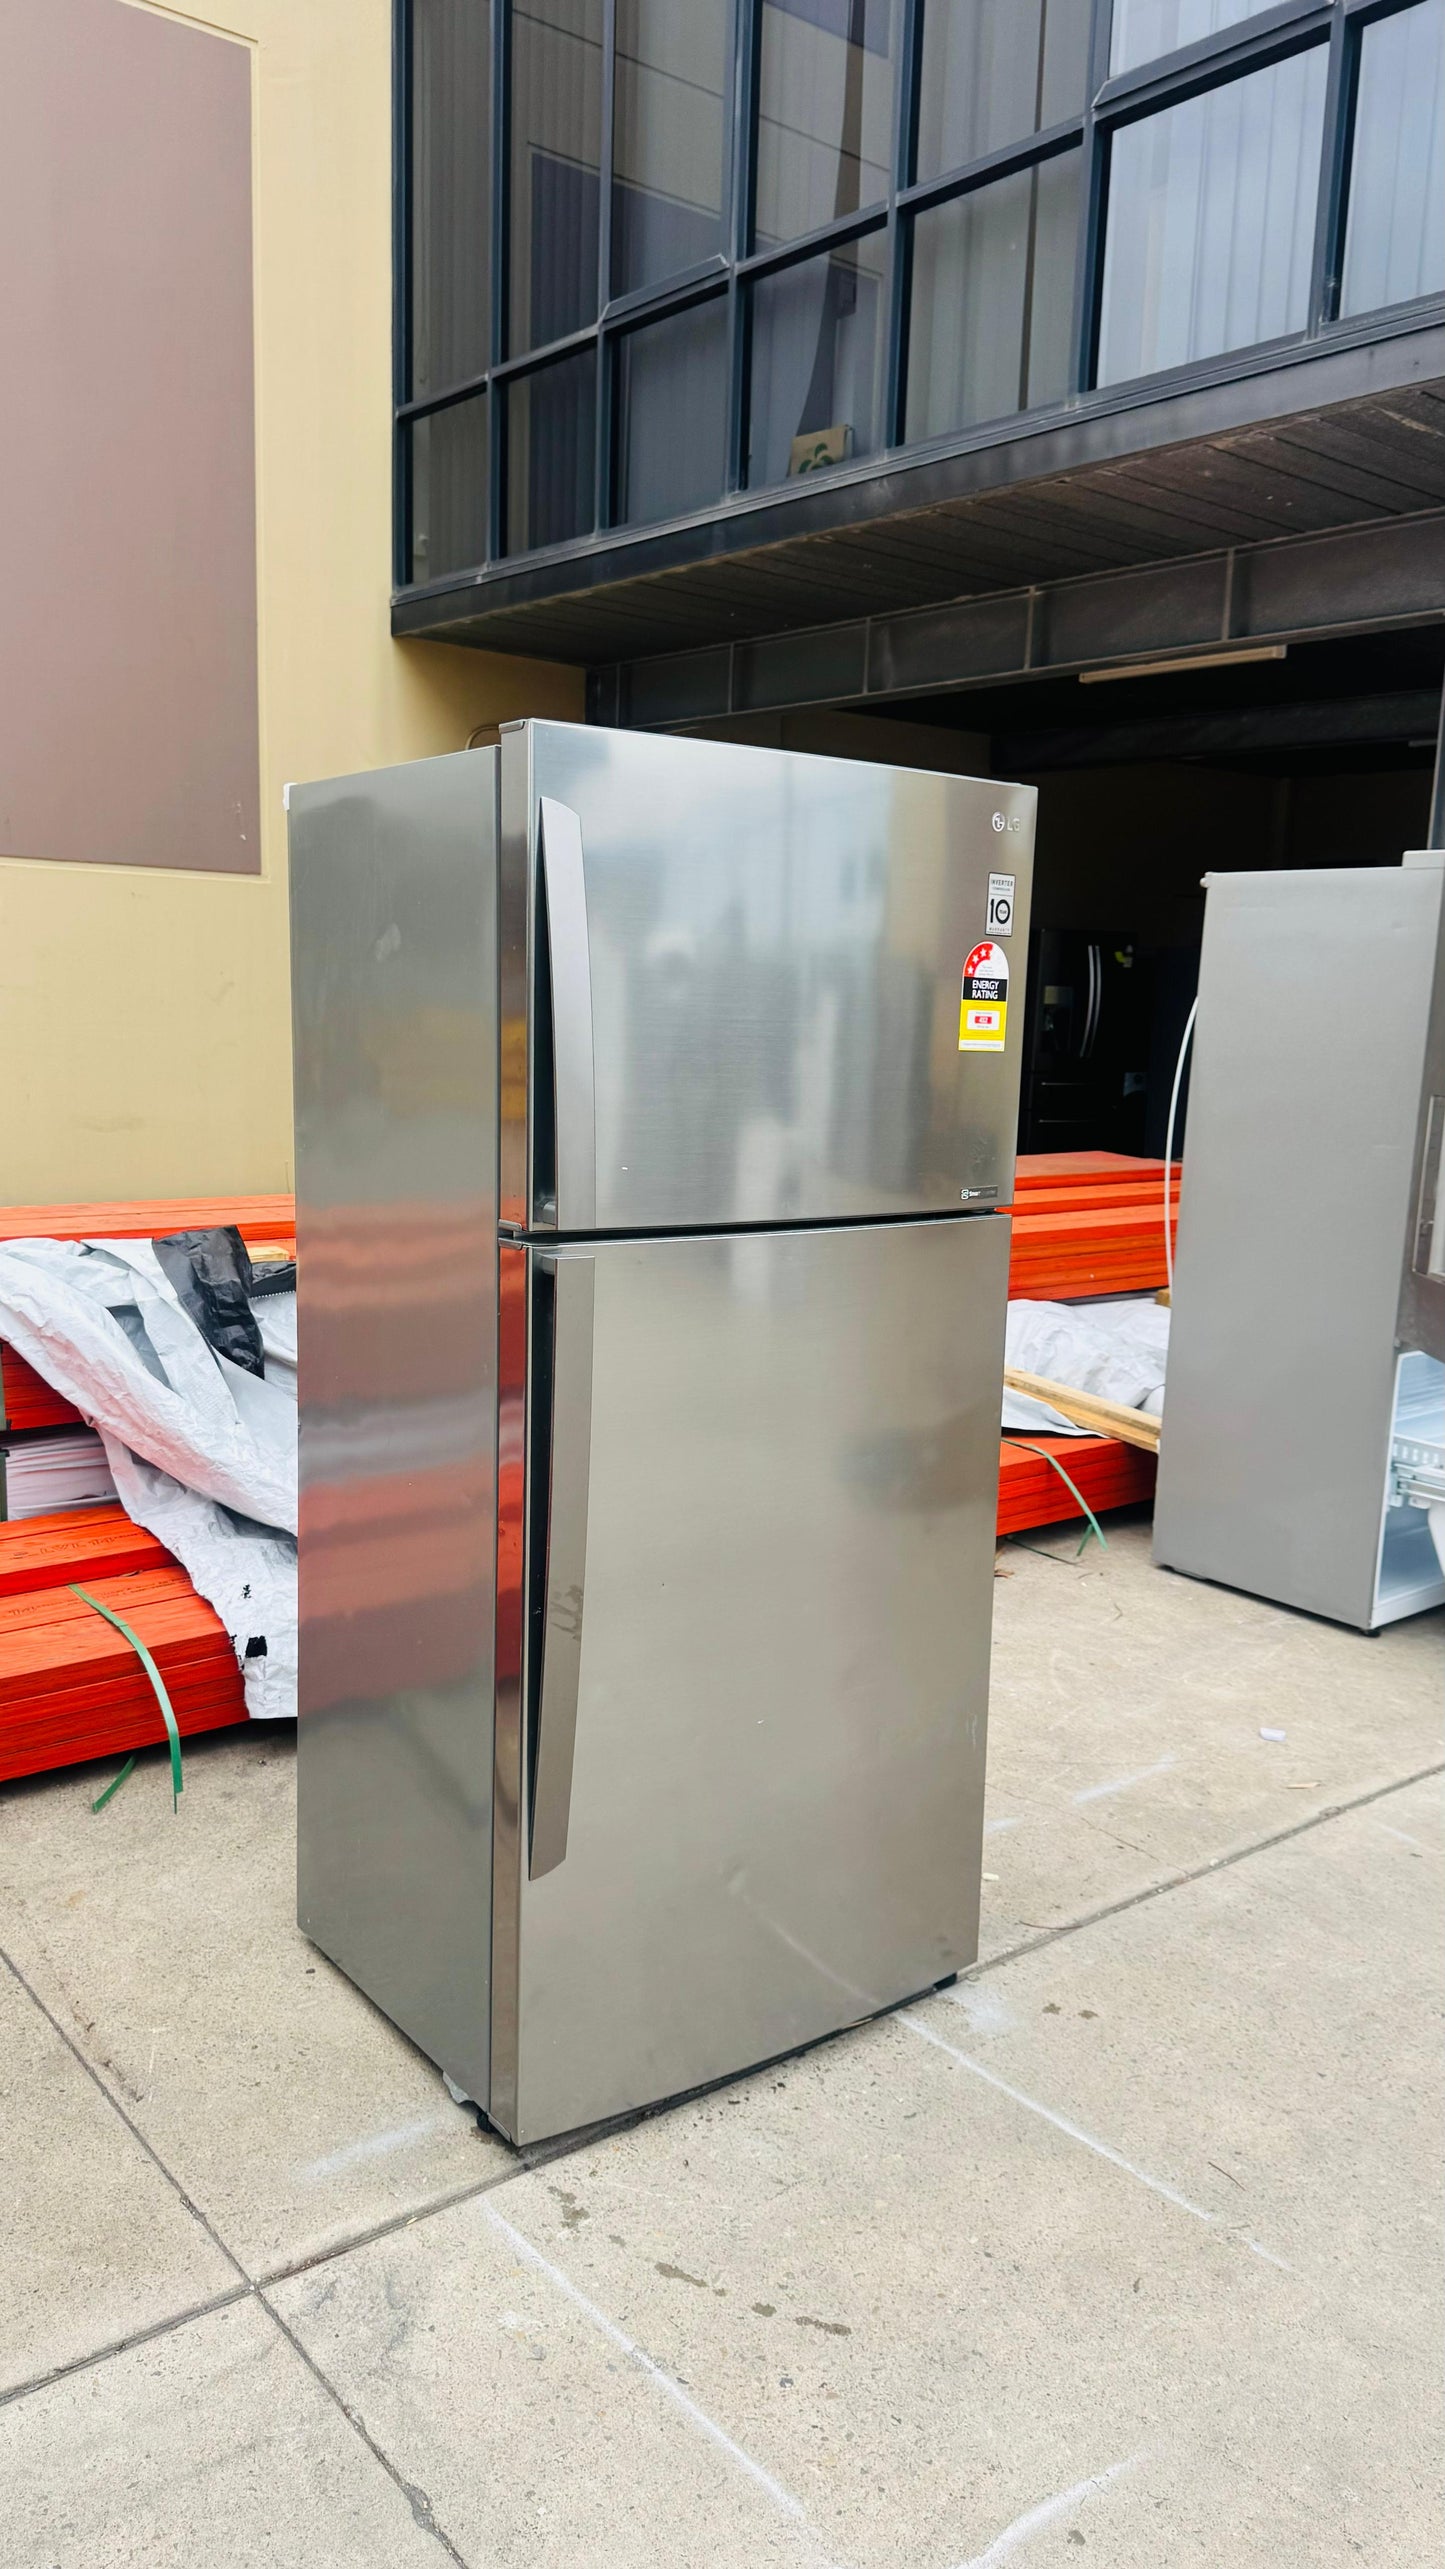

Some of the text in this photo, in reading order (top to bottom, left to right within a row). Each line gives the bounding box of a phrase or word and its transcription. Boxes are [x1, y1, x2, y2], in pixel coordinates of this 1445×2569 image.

[1006, 817, 1020, 831] LG
[990, 879, 1013, 887] INVERTER
[990, 899, 1010, 924] 10
[972, 980, 1000, 990] ENERGY
[972, 989, 998, 999] RATING
